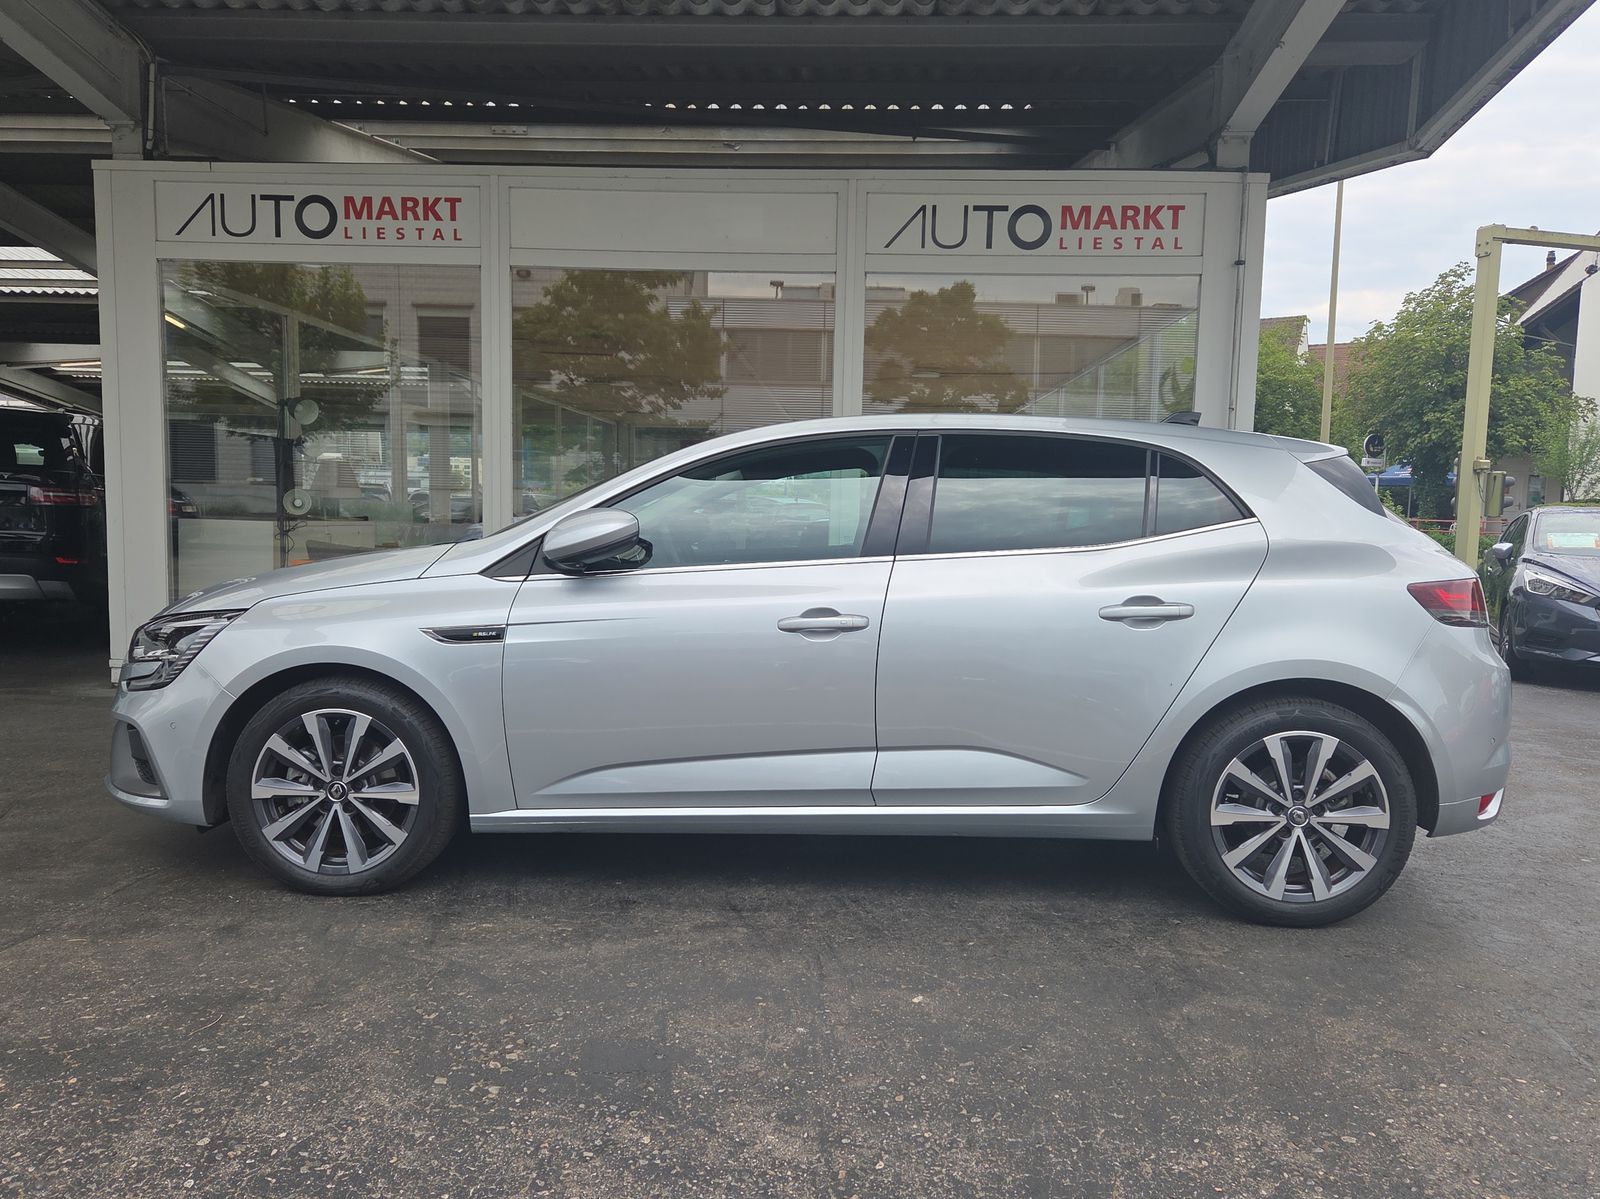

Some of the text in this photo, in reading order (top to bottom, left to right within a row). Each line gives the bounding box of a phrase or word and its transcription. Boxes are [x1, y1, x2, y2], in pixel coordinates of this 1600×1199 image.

[175, 193, 462, 240] AUTO MARKT
[884, 204, 1186, 251] AUTO MARKT
[344, 226, 462, 241] LIESTAL
[1059, 237, 1183, 250] LIESTAL
